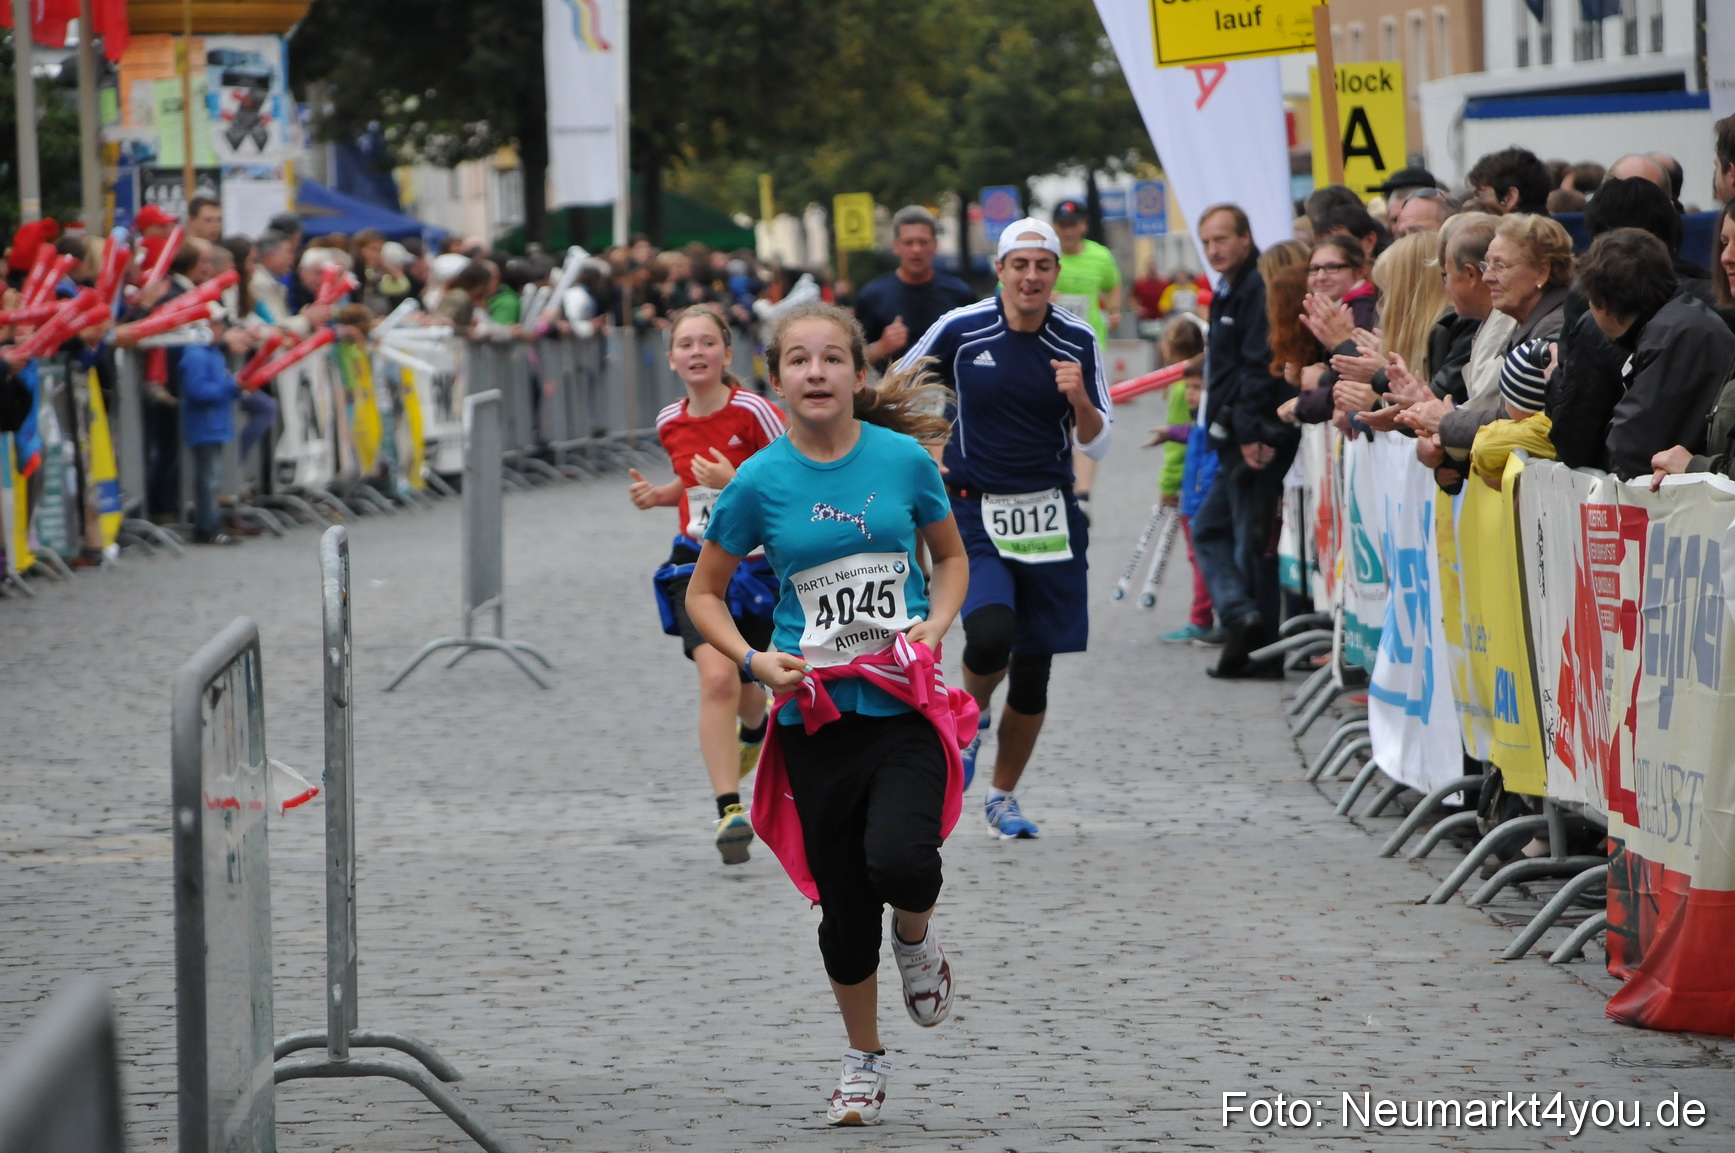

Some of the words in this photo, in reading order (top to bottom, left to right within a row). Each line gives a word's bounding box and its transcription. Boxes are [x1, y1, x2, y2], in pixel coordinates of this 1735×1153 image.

[1215, 5, 1261, 30] lauf
[1334, 67, 1393, 93] lock
[1343, 105, 1386, 170] A
[993, 503, 1059, 536] 5012
[1011, 541, 1048, 552] Marius
[797, 576, 834, 594] PARTL
[835, 564, 889, 582] Neumarkt
[815, 579, 897, 630] 4045
[835, 628, 890, 651] Amelie
